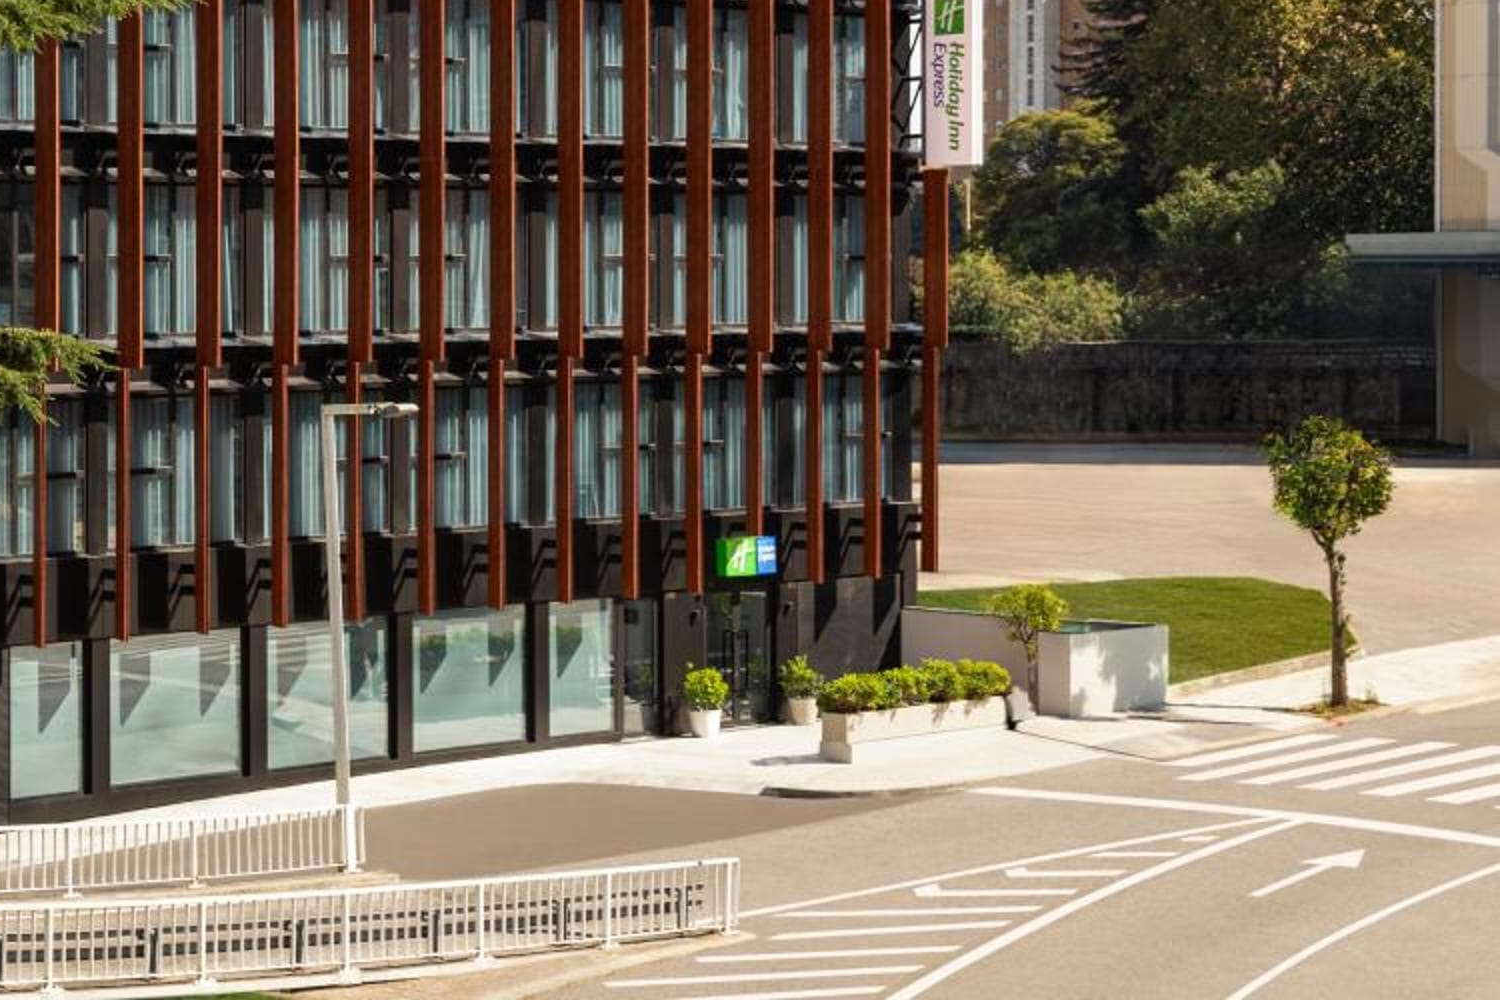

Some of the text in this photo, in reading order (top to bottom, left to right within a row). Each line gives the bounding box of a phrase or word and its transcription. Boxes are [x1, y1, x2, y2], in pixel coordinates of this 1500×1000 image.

[932, 42, 947, 108] Express
[945, 42, 965, 151] Holiday Inn
